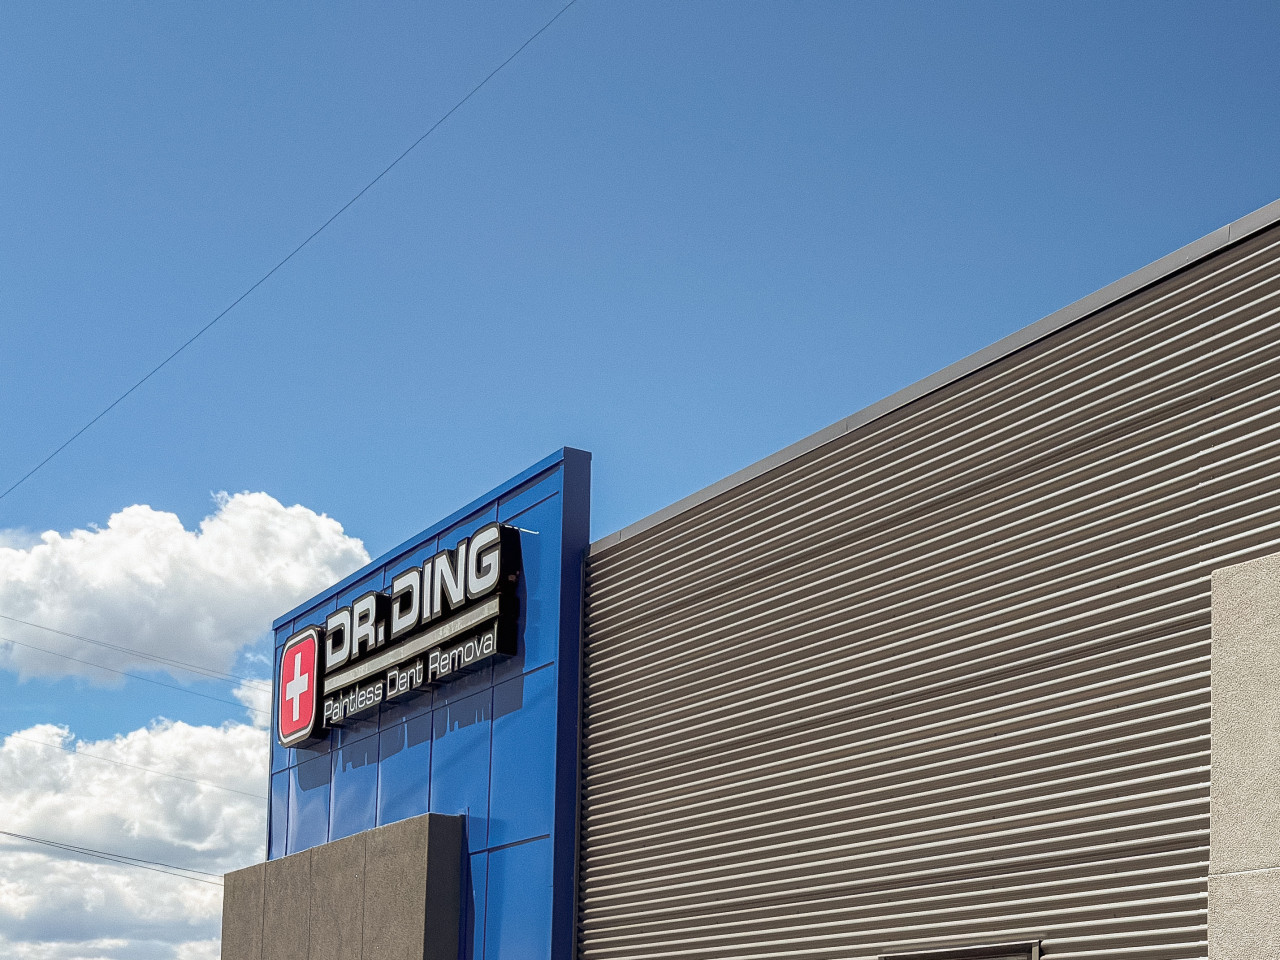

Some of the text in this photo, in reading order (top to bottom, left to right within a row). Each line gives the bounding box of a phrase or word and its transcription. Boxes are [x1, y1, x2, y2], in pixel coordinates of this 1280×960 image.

[325, 523, 500, 671] DR. DING
[323, 621, 498, 726] Paintless Dent Removal
